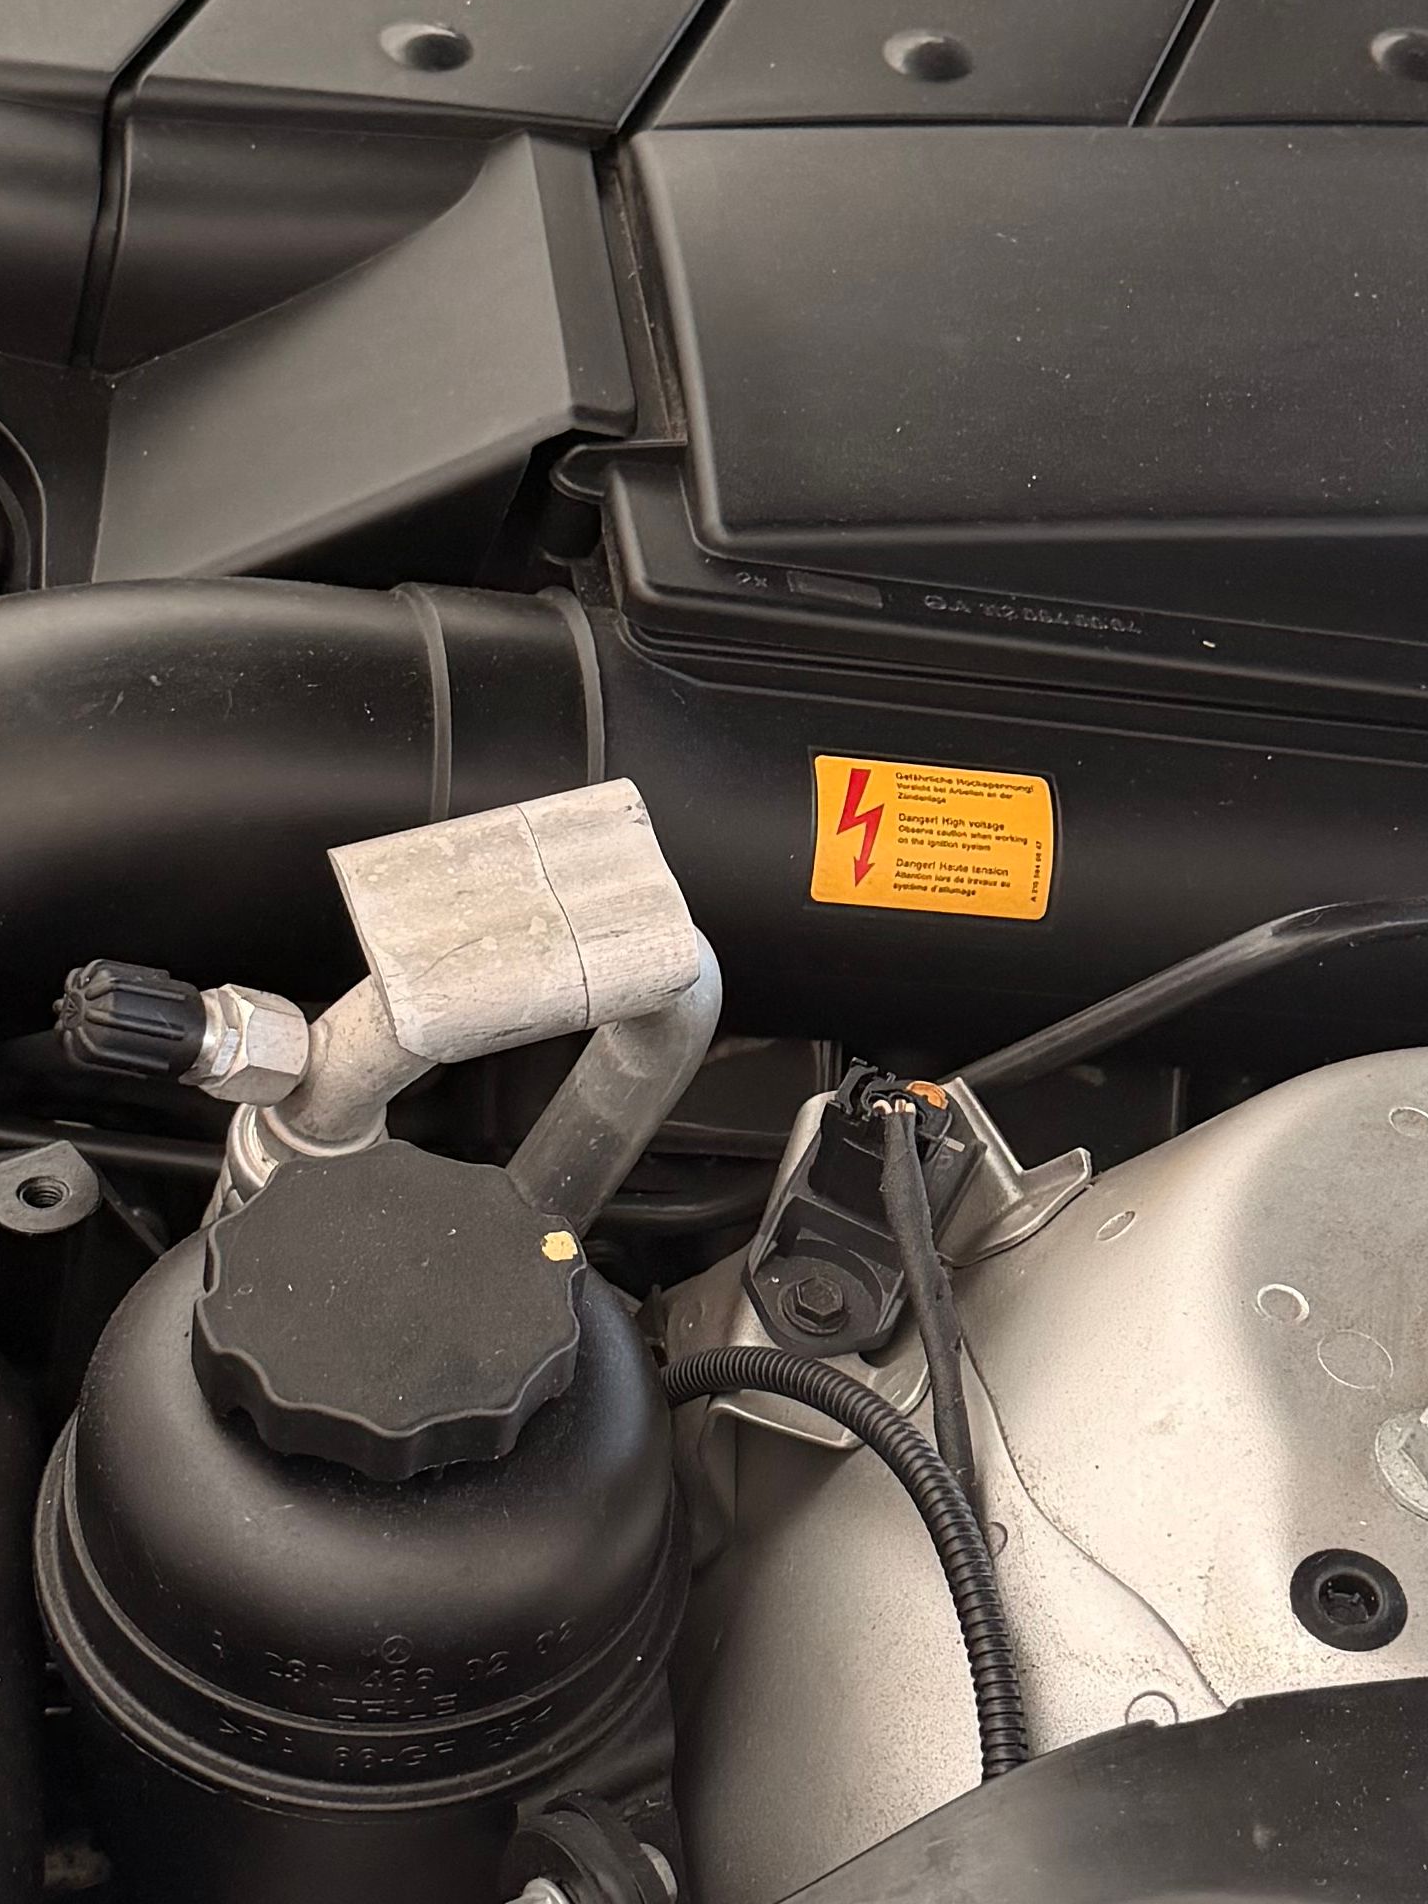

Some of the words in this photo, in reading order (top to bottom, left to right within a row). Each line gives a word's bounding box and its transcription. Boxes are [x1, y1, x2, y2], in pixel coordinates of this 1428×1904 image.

[898, 813, 938, 825] Danger!
[942, 816, 965, 828] High
[969, 819, 1005, 832] voltage
[898, 825, 933, 835] Observe
[937, 830, 968, 838] caution
[971, 832, 992, 840] when
[995, 834, 1028, 845] working
[927, 839, 959, 849] ignition
[961, 843, 991, 852] system
[895, 870, 932, 881] Attention
[896, 858, 936, 870] Danger!
[939, 862, 969, 873] Haute
[972, 864, 1009, 877] tension
